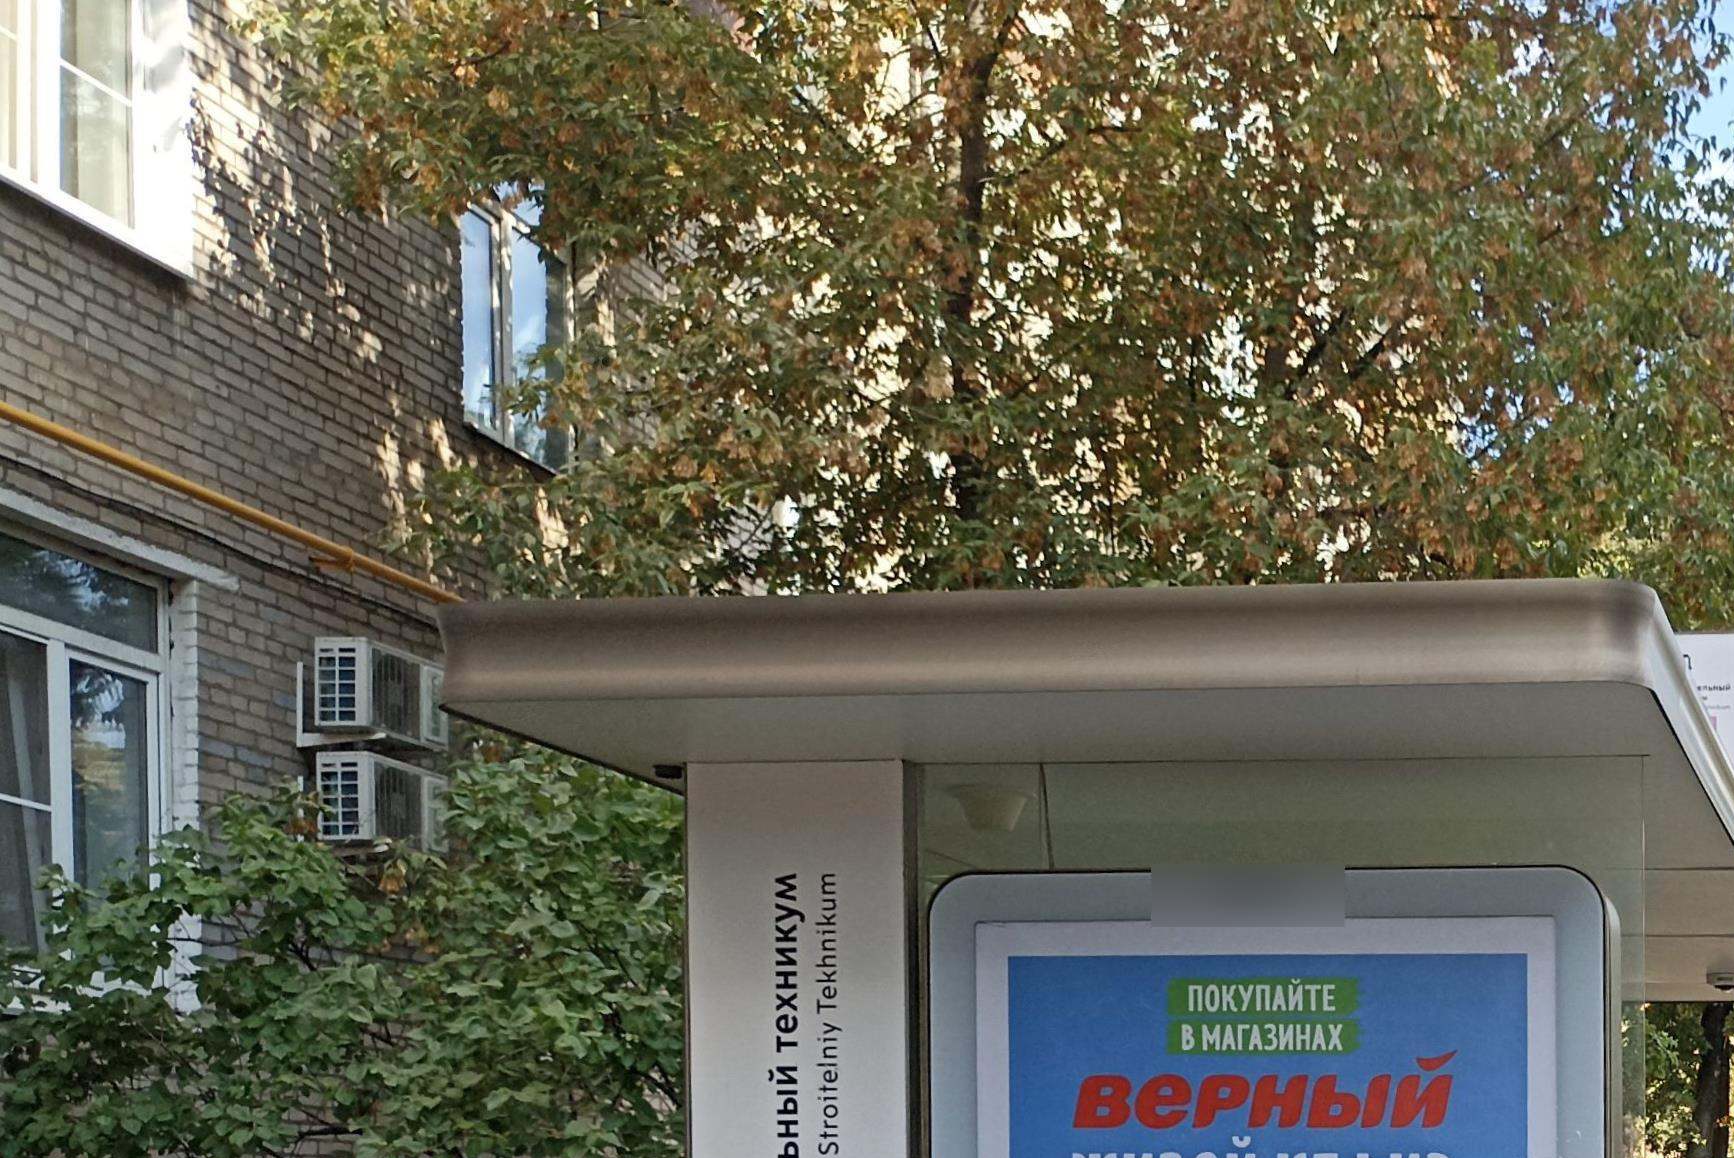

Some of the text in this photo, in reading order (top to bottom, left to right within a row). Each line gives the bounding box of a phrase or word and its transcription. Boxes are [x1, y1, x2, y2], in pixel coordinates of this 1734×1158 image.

[774, 873, 805, 1053] техникум
[815, 873, 842, 1155] Stroitelniy Tekhnikum
[1188, 978, 1336, 1013] ПОКУПАЙТЕ
[1181, 1023, 1344, 1051] В МАГАЗИНАХ
